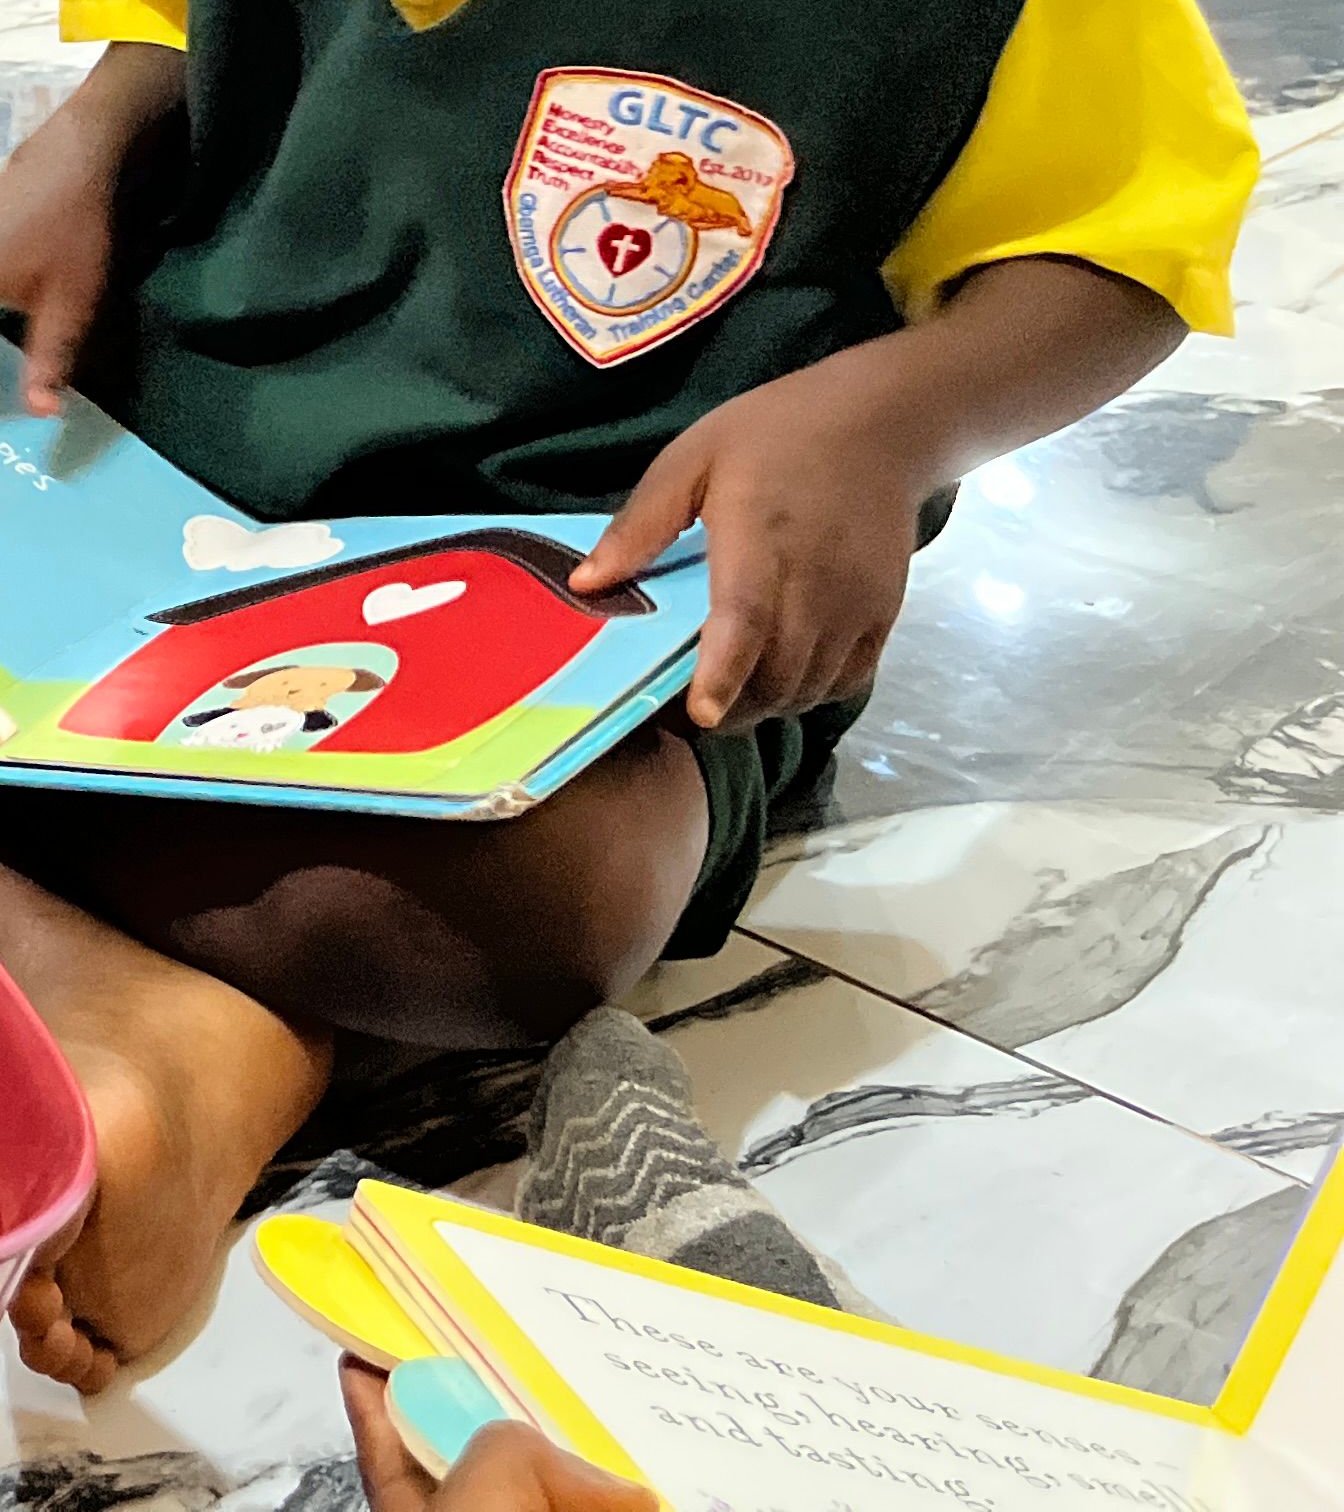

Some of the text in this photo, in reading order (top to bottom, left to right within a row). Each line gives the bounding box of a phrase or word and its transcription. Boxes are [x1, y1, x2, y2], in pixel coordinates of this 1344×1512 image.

[607, 90, 739, 153] GLTC
[543, 1287, 1141, 1467] These are your senses
[603, 1350, 1061, 1491] seeing, hearing,
[650, 1403, 763, 1449] and
